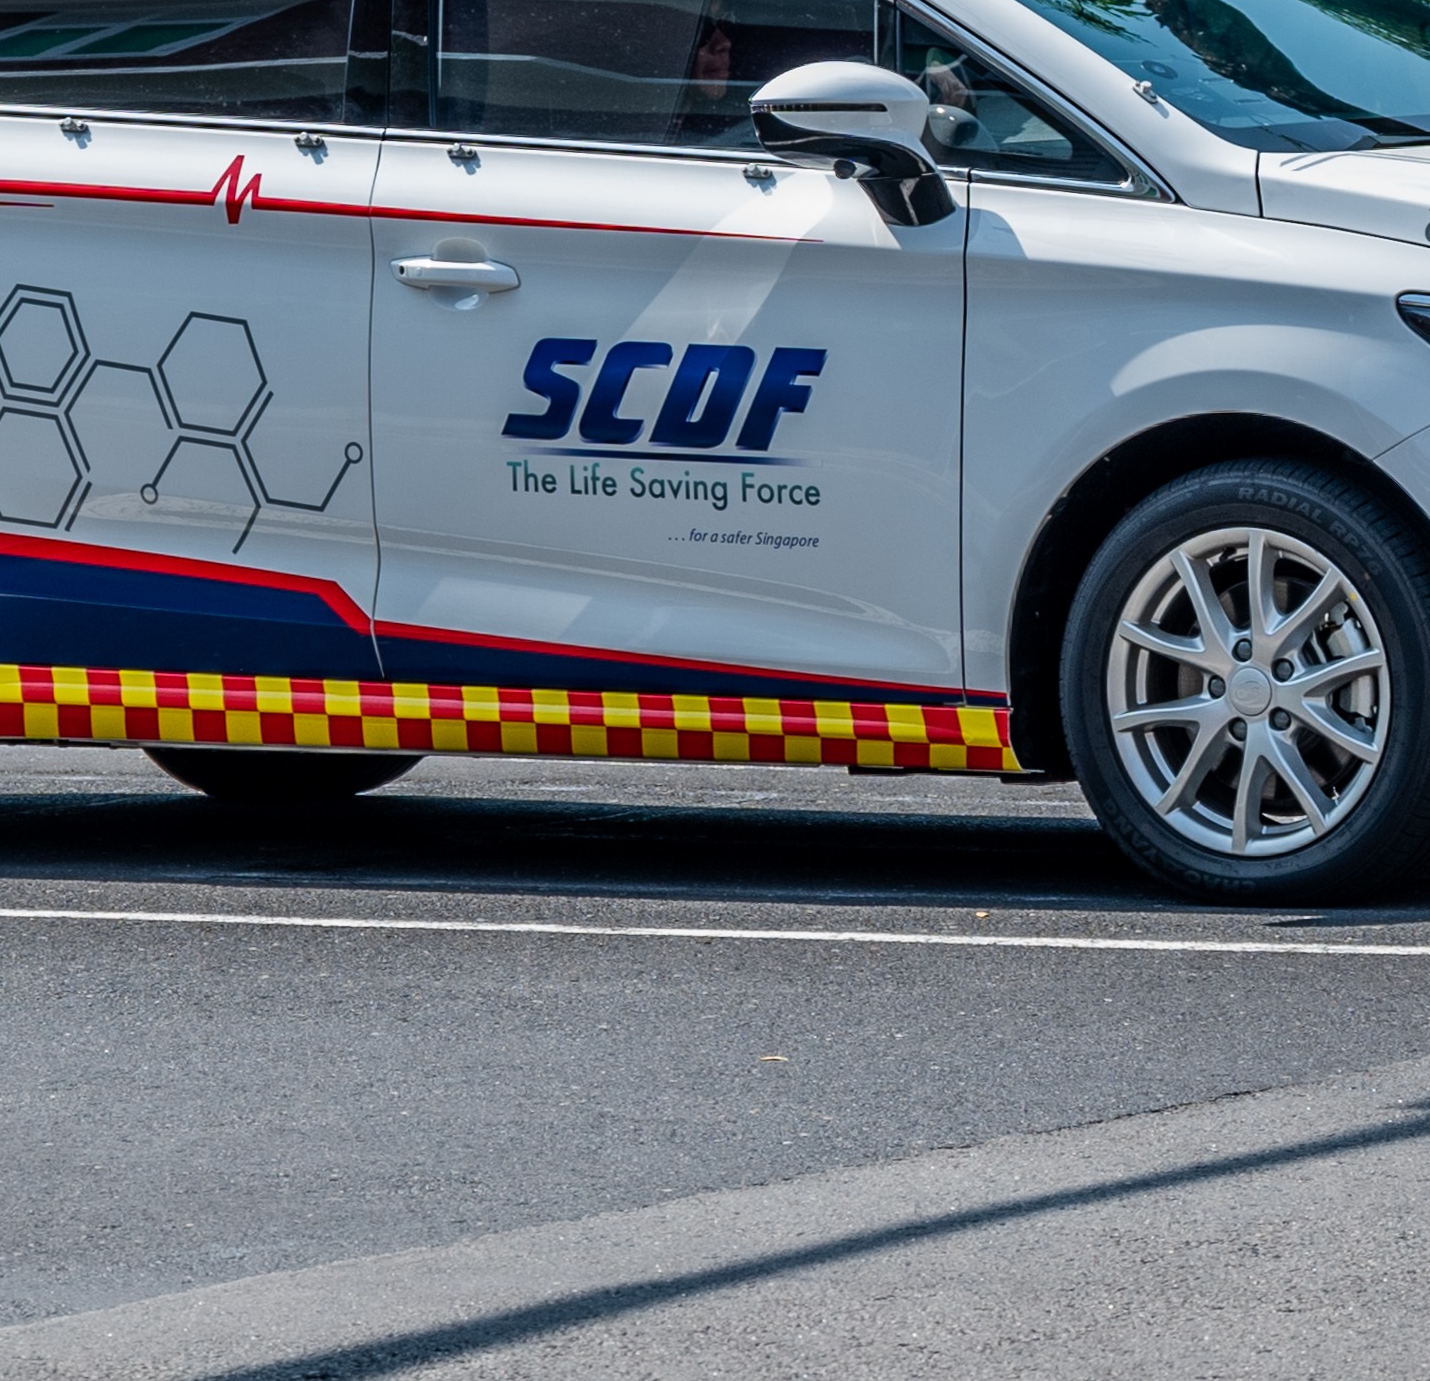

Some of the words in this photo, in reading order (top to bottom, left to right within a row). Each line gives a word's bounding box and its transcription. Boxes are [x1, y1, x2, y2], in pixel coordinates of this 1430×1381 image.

[501, 337, 828, 451] SCDF
[506, 459, 558, 494] The
[570, 462, 618, 497] Life
[629, 467, 728, 512] Saving
[741, 472, 821, 507] Force
[689, 528, 708, 542] for
[710, 532, 719, 543] a
[720, 530, 753, 545] safer
[755, 531, 820, 550] Singapore
[1236, 487, 1324, 523] RADIAL
[1328, 520, 1383, 576] RP76
